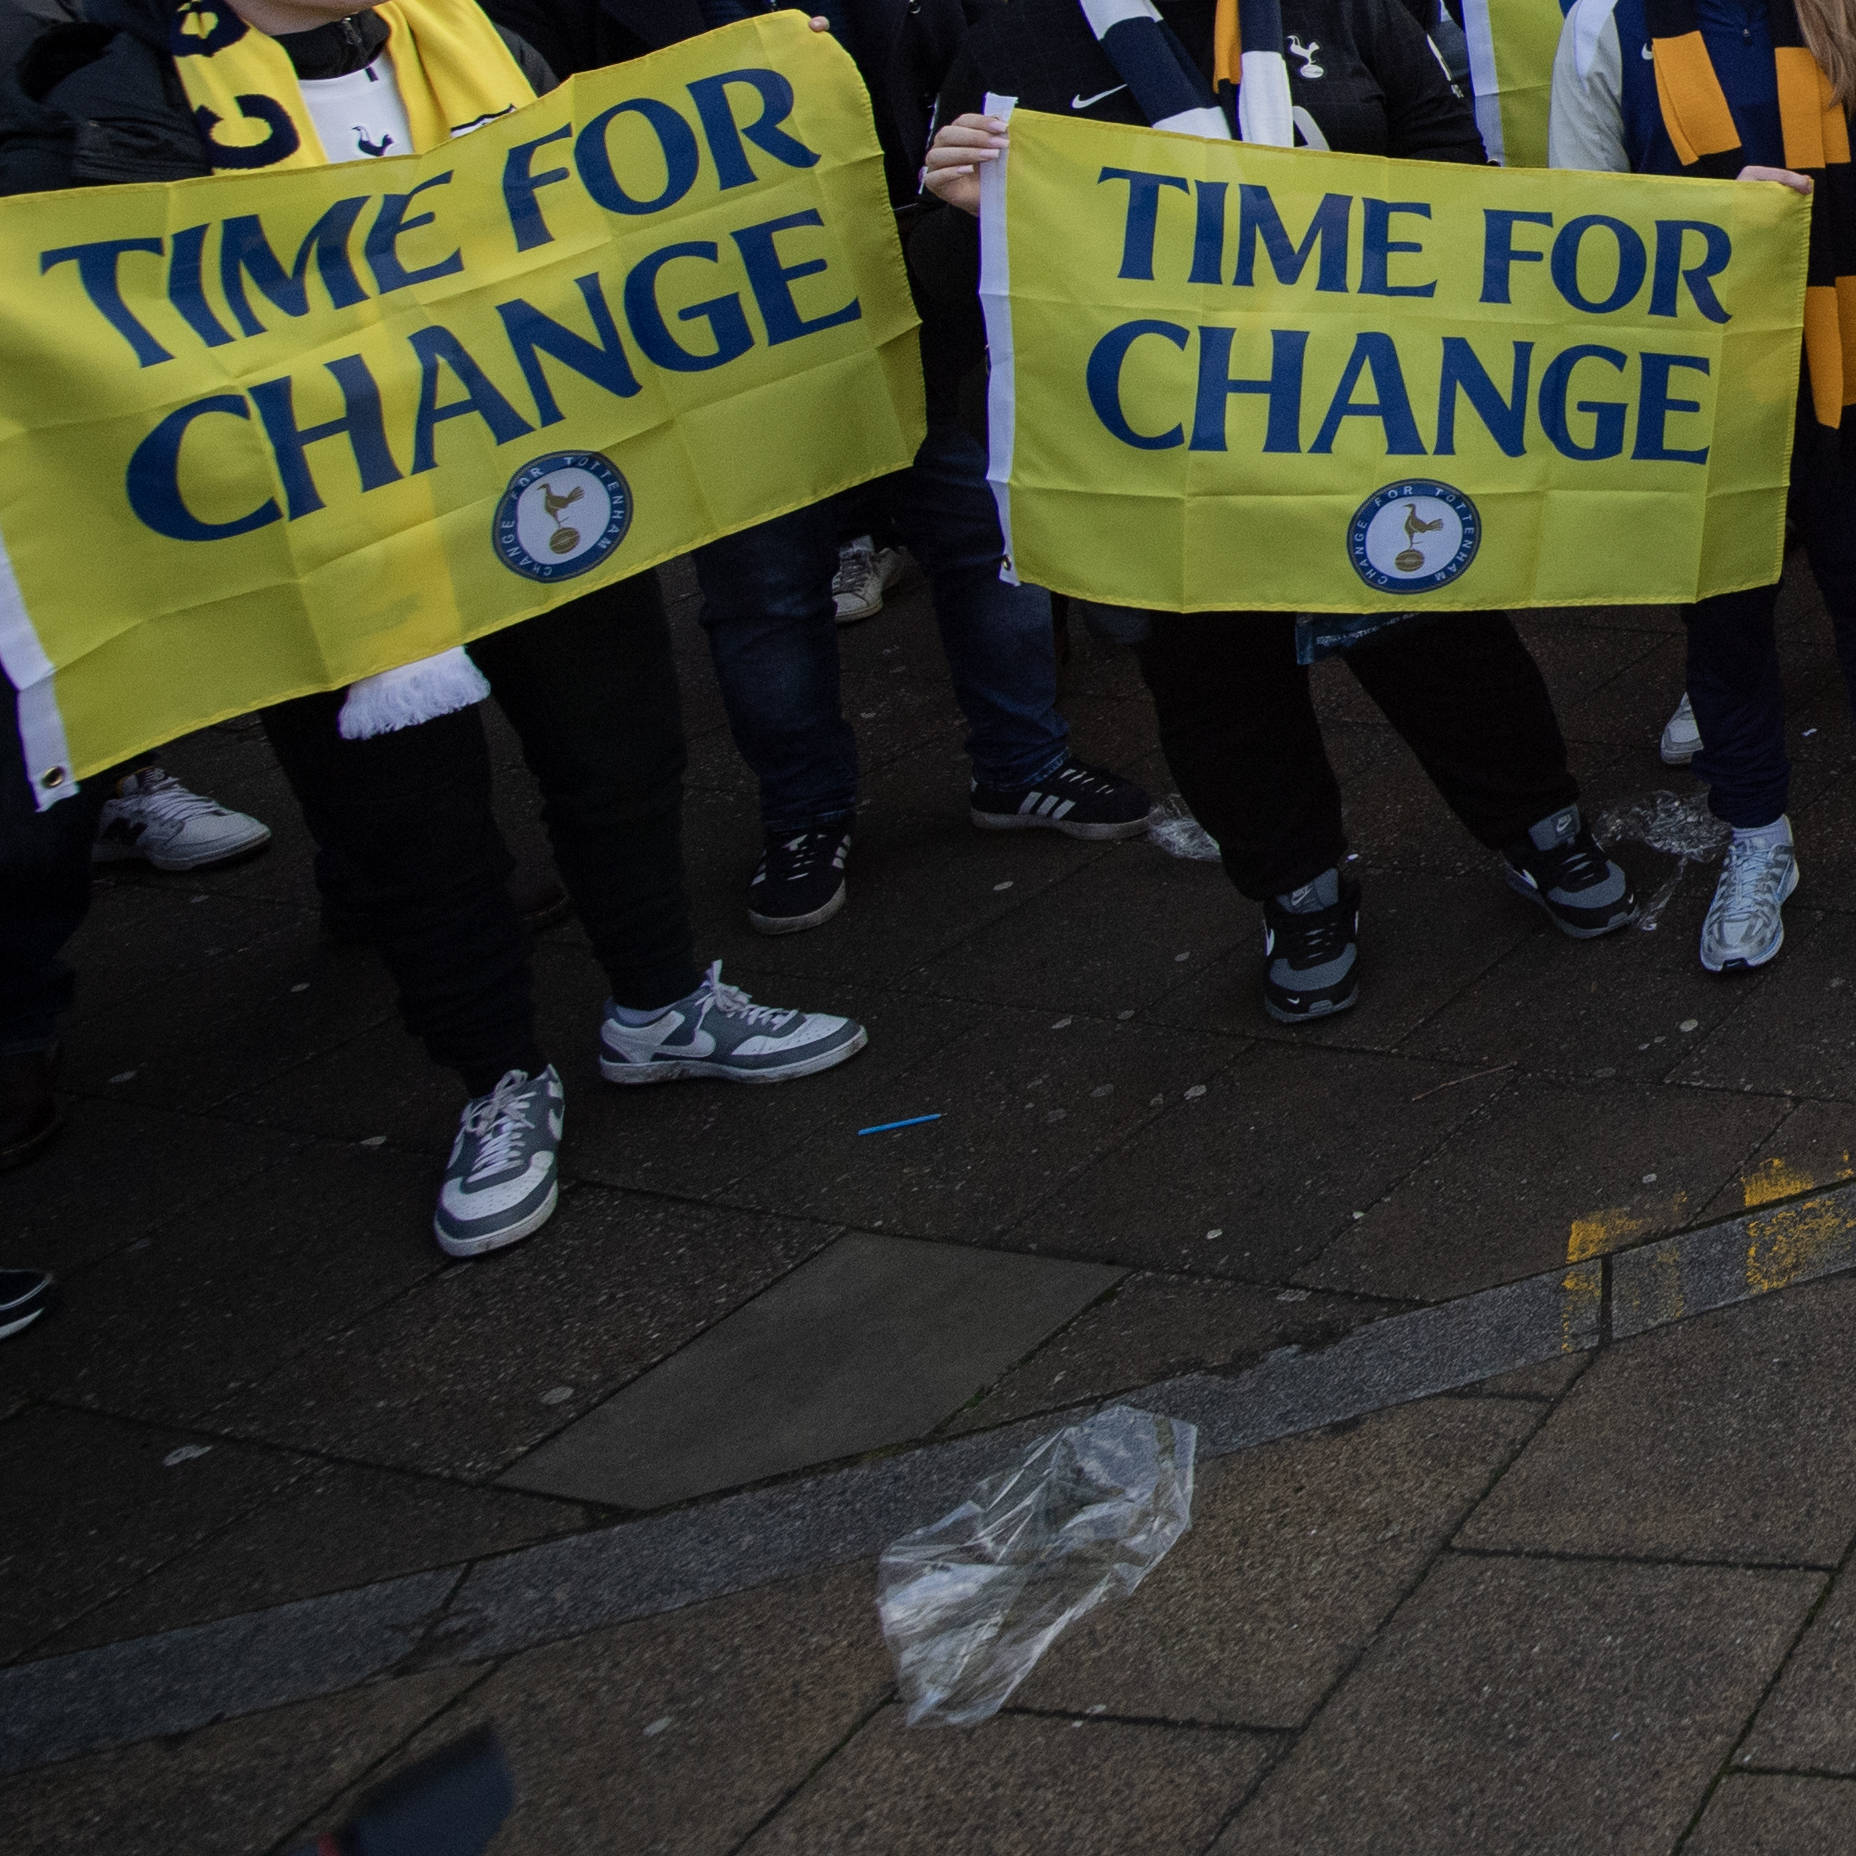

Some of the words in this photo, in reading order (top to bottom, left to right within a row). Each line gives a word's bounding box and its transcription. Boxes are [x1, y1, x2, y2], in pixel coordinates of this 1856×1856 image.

[41, 172, 464, 369] TIME
[501, 66, 818, 252] FOR
[1097, 167, 1436, 299] TIME
[1482, 210, 1733, 323] FOR
[127, 208, 861, 543] CHANGE
[1085, 320, 1711, 465] CHANGE
[563, 456, 626, 549] TOTTENHAM
[1354, 519, 1389, 585] CHANGE
[1374, 485, 1414, 507] FOR
[1433, 487, 1475, 581] TOTTENHAM
